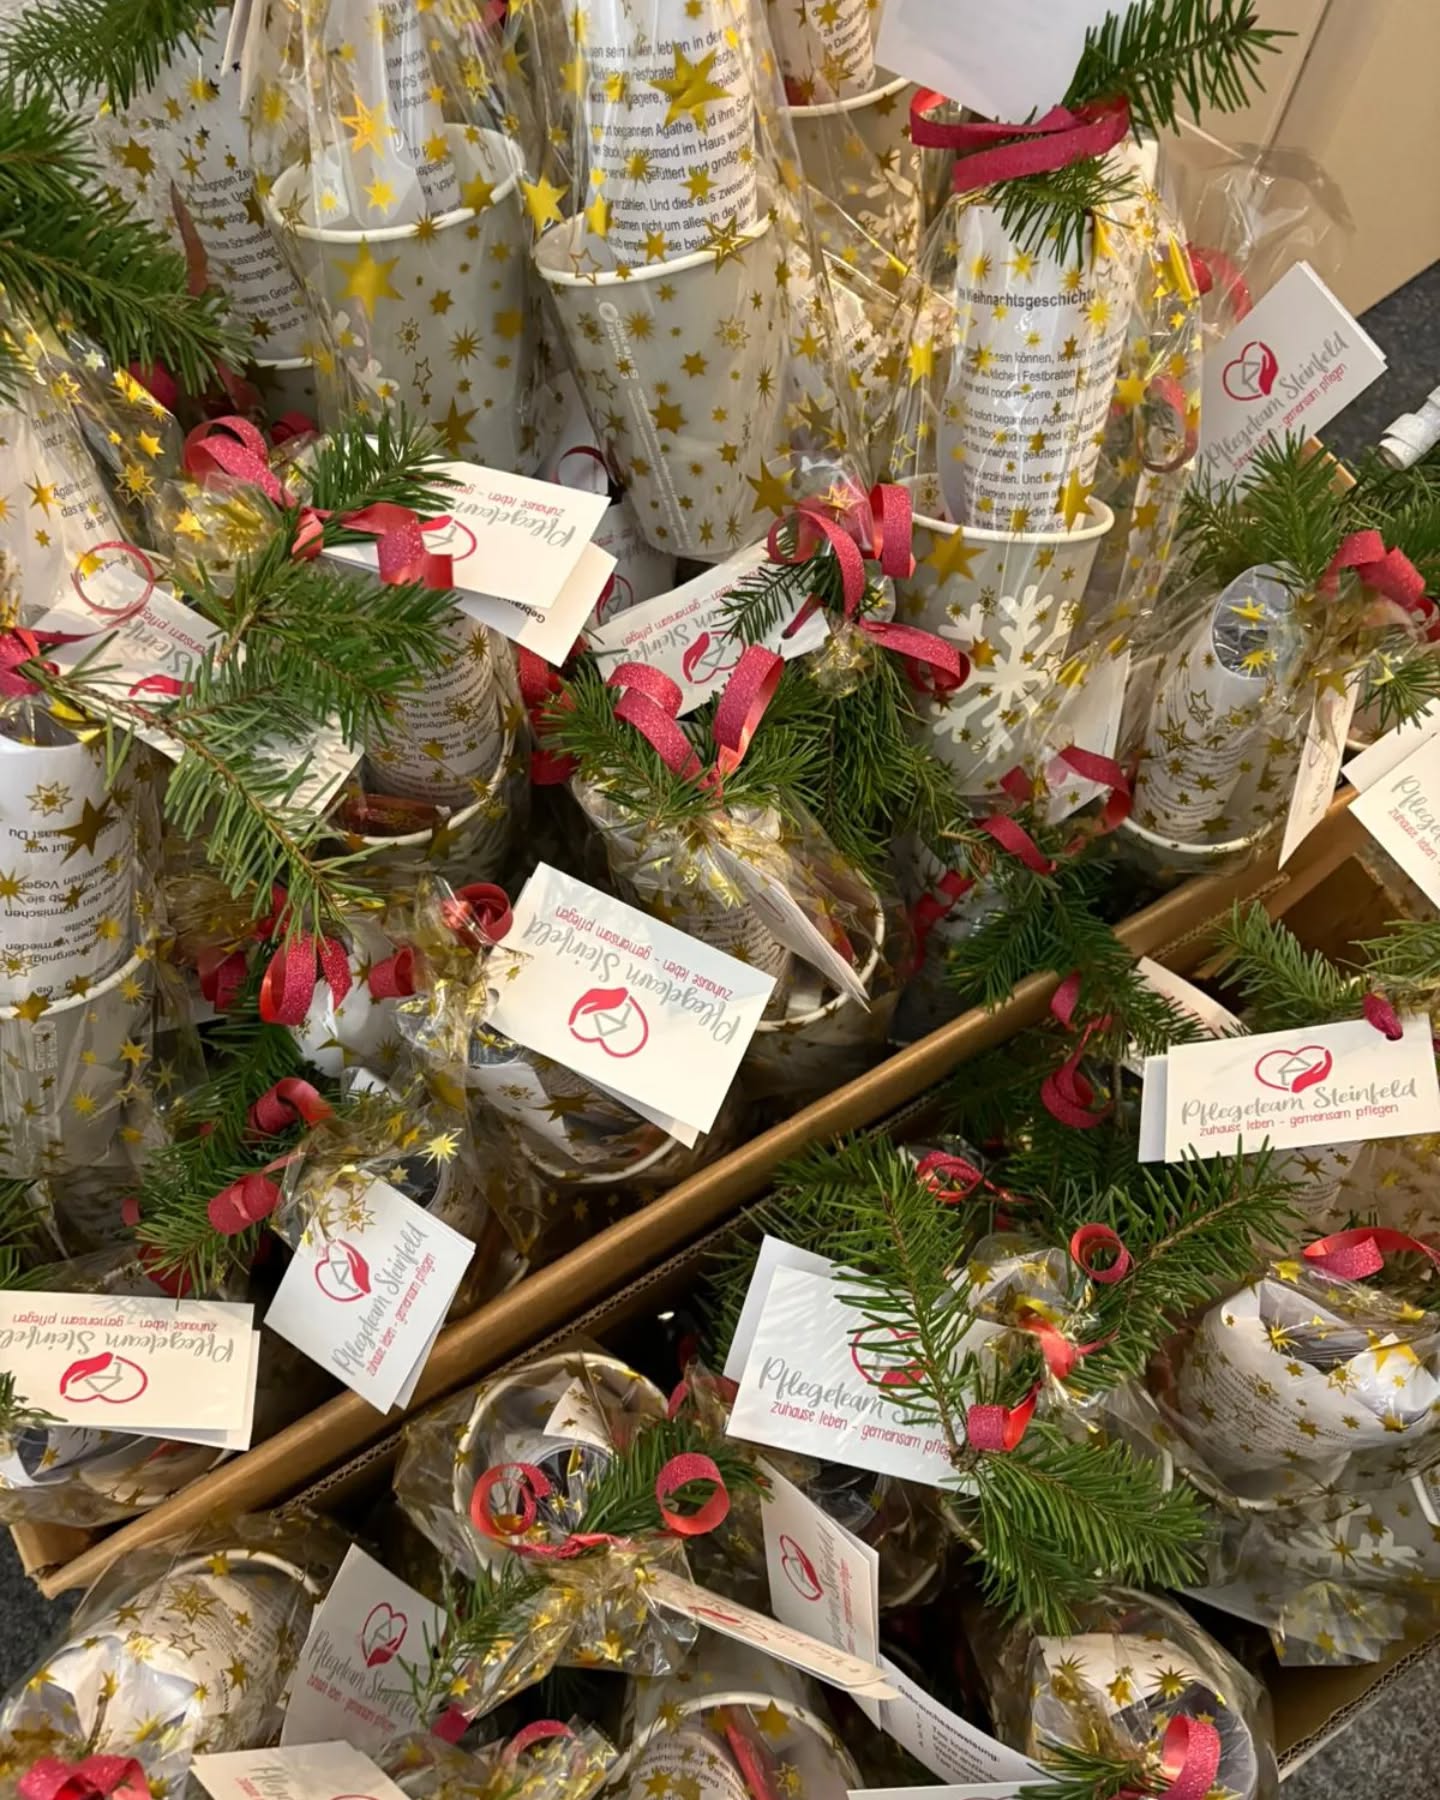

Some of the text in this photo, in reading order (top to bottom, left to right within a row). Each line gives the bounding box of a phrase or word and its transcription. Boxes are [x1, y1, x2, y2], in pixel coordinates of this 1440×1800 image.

[655, 120, 693, 140] Agathe
[697, 135, 726, 151] Haus
[651, 198, 670, 211] Und
[664, 219, 681, 231] um
[1015, 351, 1055, 364] können,
[1280, 331, 1349, 400] Steinfeld
[1023, 368, 1075, 383] Festbraten
[1021, 475, 1043, 485] Und
[488, 491, 518, 506] leben
[520, 498, 566, 517] zuhause
[9, 828, 28, 840] Du
[27, 894, 47, 904] sie
[555, 905, 595, 934] pflegen
[522, 913, 621, 984] Steinfeld
[594, 924, 652, 961] gemeinsam
[662, 957, 691, 983] leben
[690, 973, 735, 1002] zuhause
[624, 964, 742, 1046] Pflegeteam
[1181, 1078, 1418, 1127] Pflegeteam Steinfeld
[1200, 1121, 1242, 1138] zuhause
[1246, 1117, 1275, 1132] leben
[1290, 1106, 1351, 1129] gemeinsam
[1355, 1103, 1399, 1123] pflegen
[331, 1220, 429, 1377] Pflegeteam Steinfeld
[12, 1310, 58, 1327] pflegen
[60, 1313, 126, 1329] gemeinsam
[139, 1319, 169, 1332] leben
[173, 1319, 218, 1333] zuhause
[105, 1331, 235, 1363] Pflegeteam
[759, 1356, 885, 1419] Pflegeteam
[770, 1401, 814, 1422] zuhause
[820, 1411, 848, 1431] leben
[862, 1423, 921, 1449] gemeinsam
